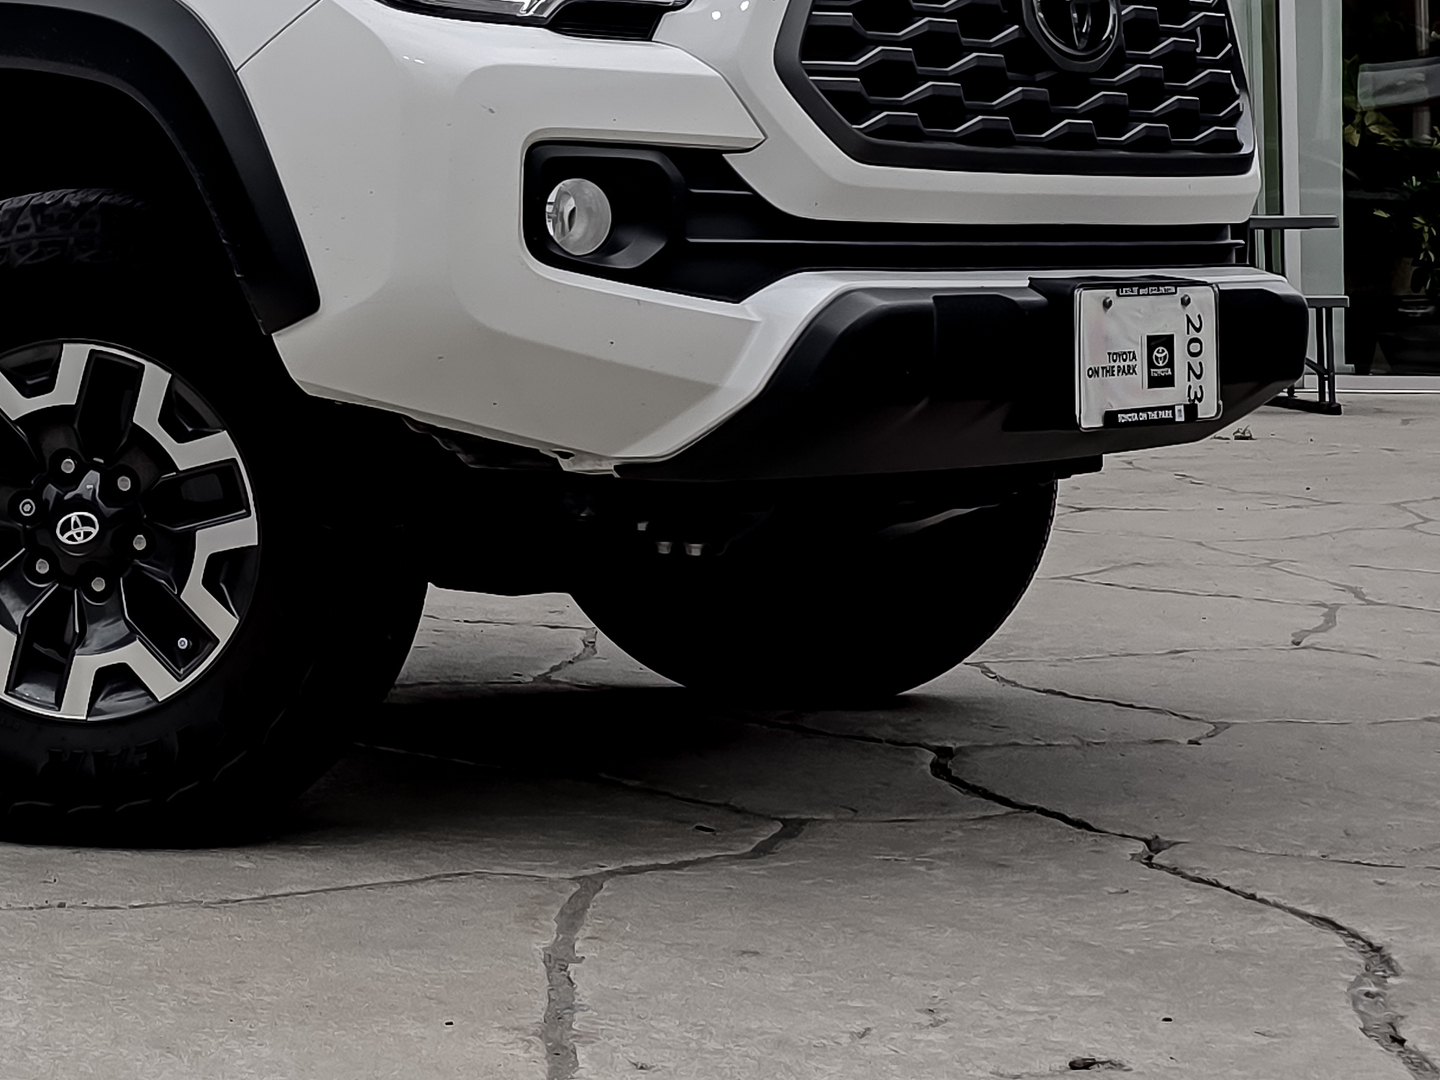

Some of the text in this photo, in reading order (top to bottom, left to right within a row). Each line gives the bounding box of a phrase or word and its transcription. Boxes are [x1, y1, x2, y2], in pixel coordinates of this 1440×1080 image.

[1107, 350, 1137, 364] TOYOTA
[1185, 313, 1204, 404] 2023
[1087, 364, 1138, 379] ON THE PARK
